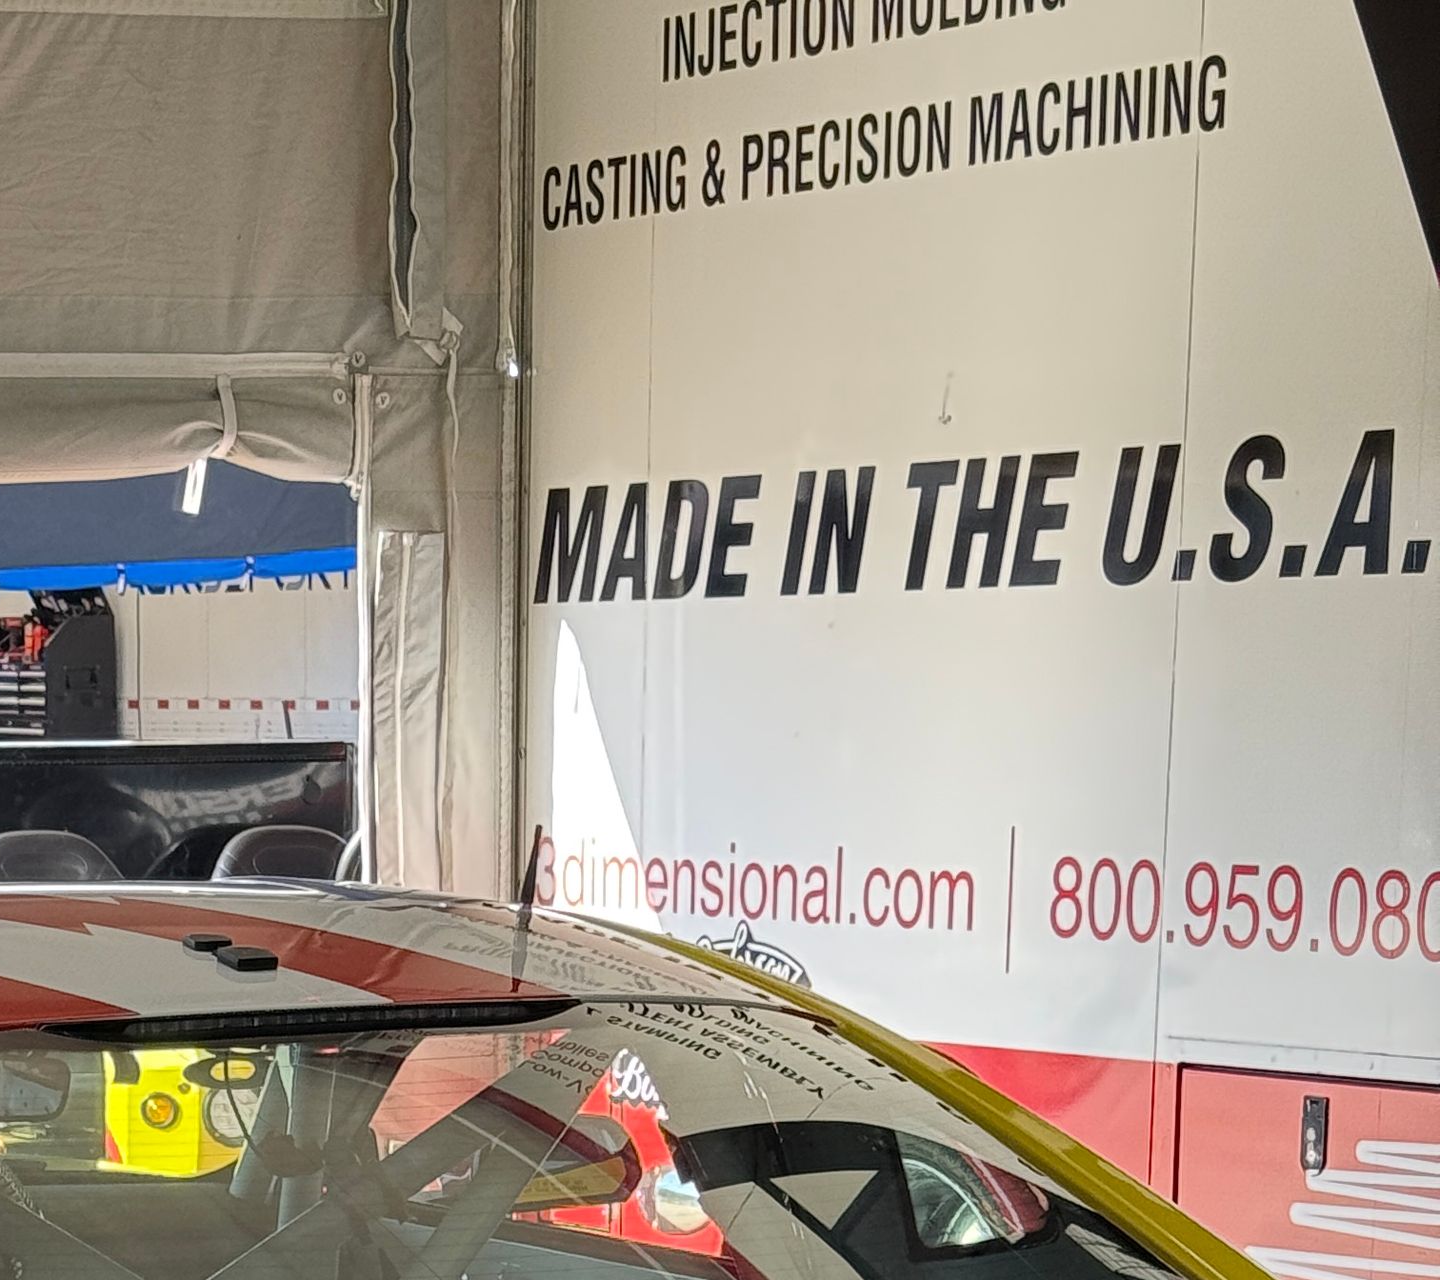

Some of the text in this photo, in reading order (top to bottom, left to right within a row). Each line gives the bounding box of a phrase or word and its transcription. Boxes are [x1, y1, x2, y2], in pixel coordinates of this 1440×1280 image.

[541, 53, 1228, 232] CASTING & PRECISION MACHINING
[532, 428, 1433, 606] MADE IN THE U.S.A.
